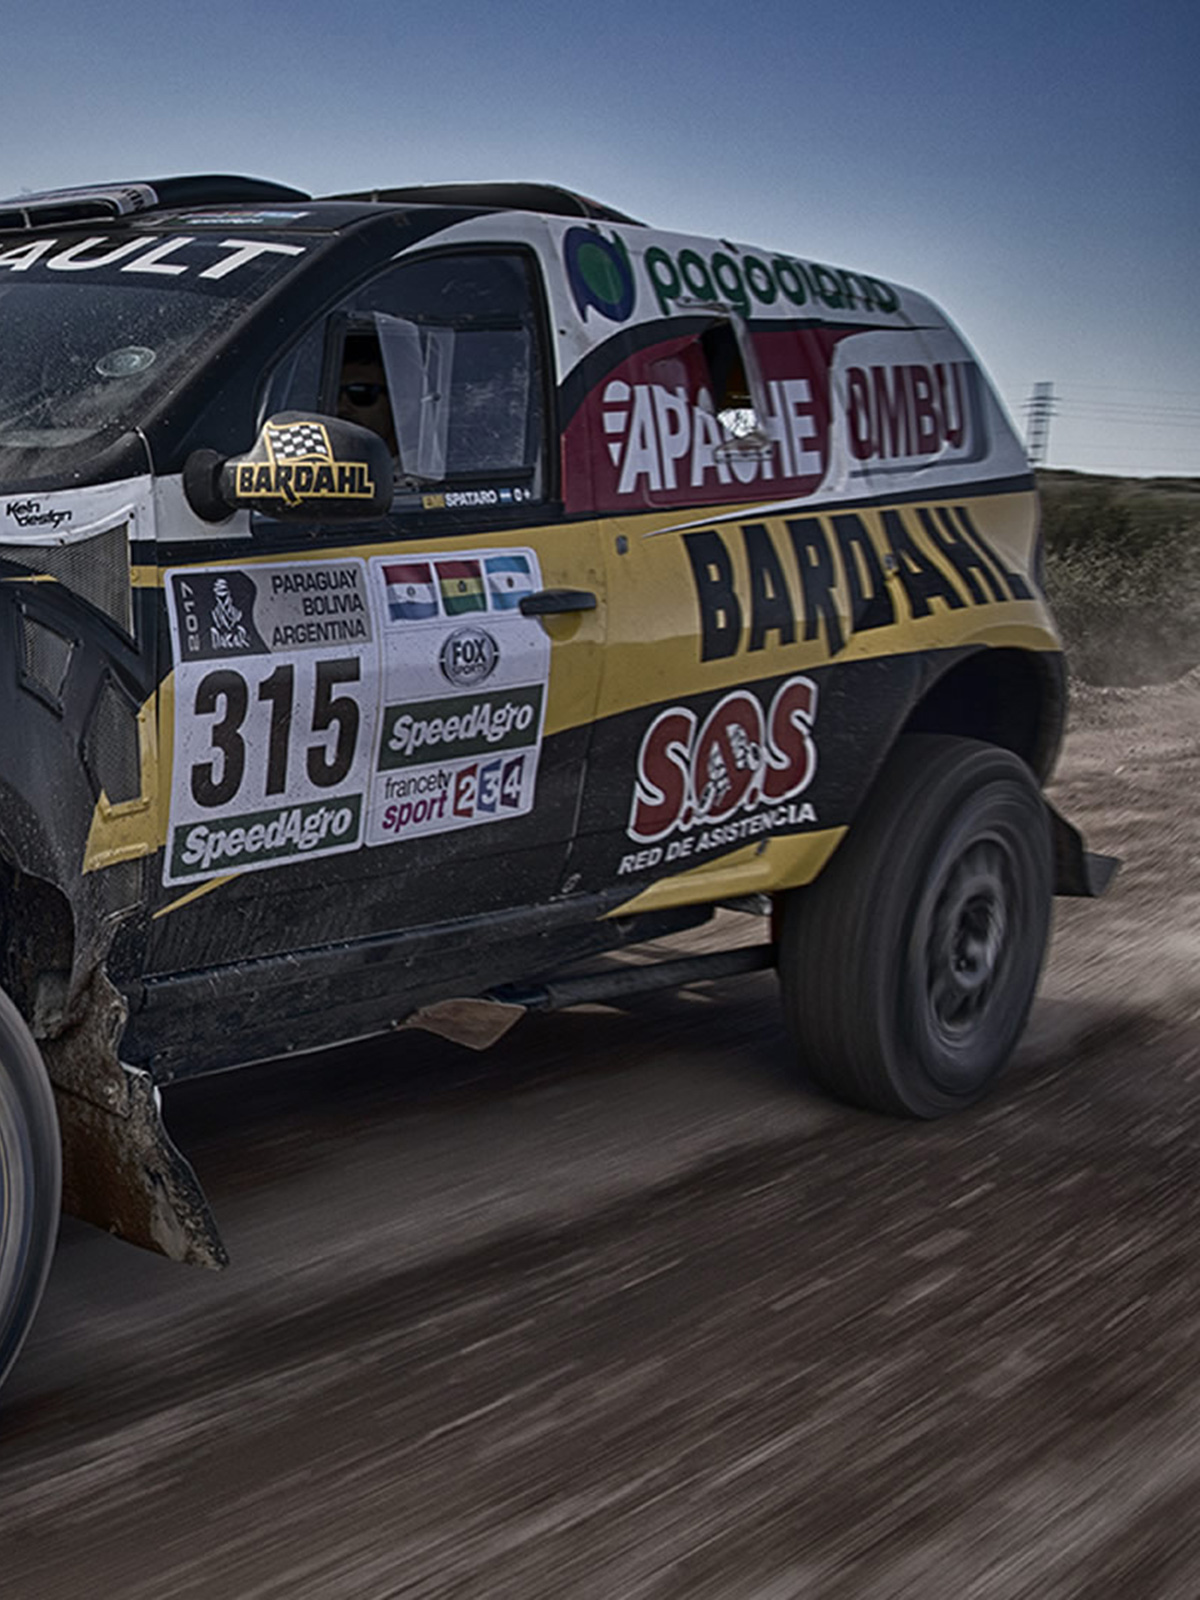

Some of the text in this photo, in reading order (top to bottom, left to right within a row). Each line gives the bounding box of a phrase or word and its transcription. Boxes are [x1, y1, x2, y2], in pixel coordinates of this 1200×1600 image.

[233, 462, 375, 508] BARDAHL
[445, 489, 498, 508] SPATARO
[271, 569, 358, 595] PARAGUAY
[681, 506, 1036, 662] BARDAHL
[302, 593, 365, 616] BOLIVIA
[272, 618, 367, 646] ARGENTINA
[452, 638, 487, 666] FOX
[191, 656, 360, 807] 315
[388, 702, 534, 754] SpeedAgro
[382, 790, 447, 833] sport
[181, 804, 353, 869] SpeedAgro
[617, 803, 818, 875] RED DE ASISTENCIA
